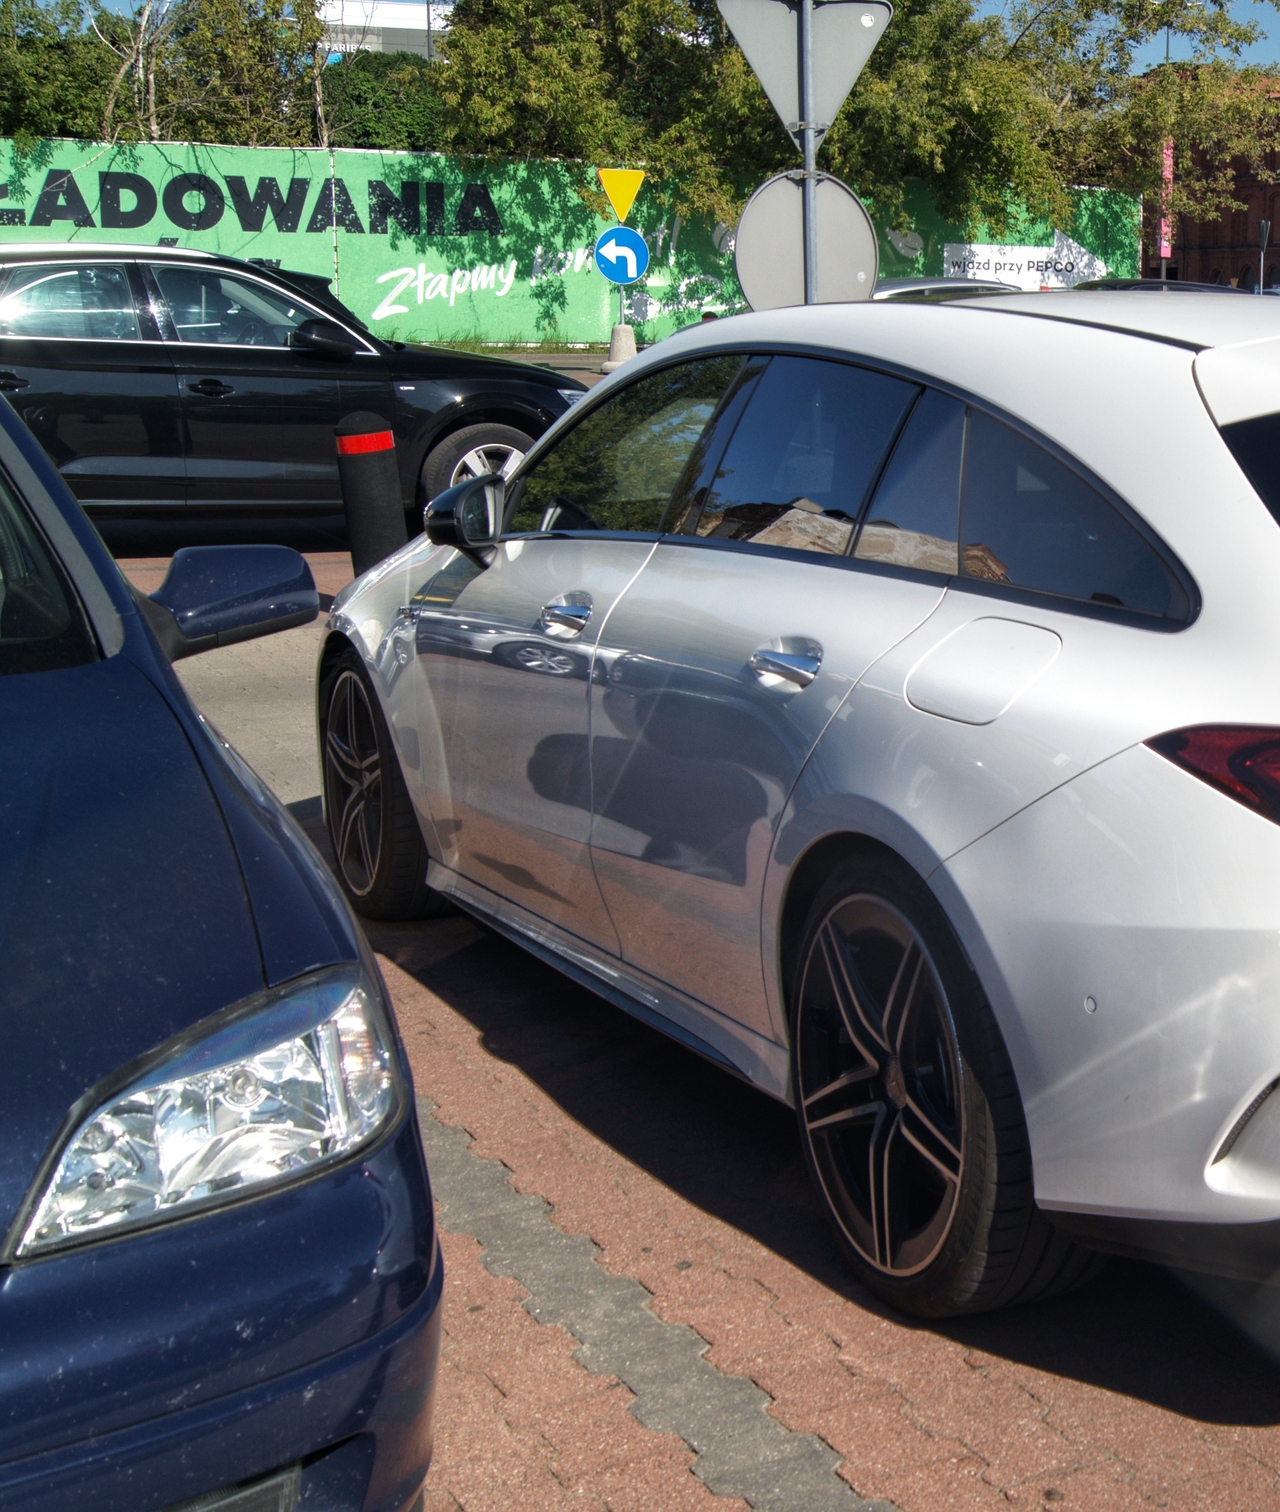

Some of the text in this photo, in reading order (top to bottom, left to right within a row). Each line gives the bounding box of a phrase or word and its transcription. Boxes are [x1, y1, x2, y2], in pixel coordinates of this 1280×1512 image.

[951, 257, 1075, 275] wjazd przy PEPCO
[371, 259, 518, 322] Złapmy
